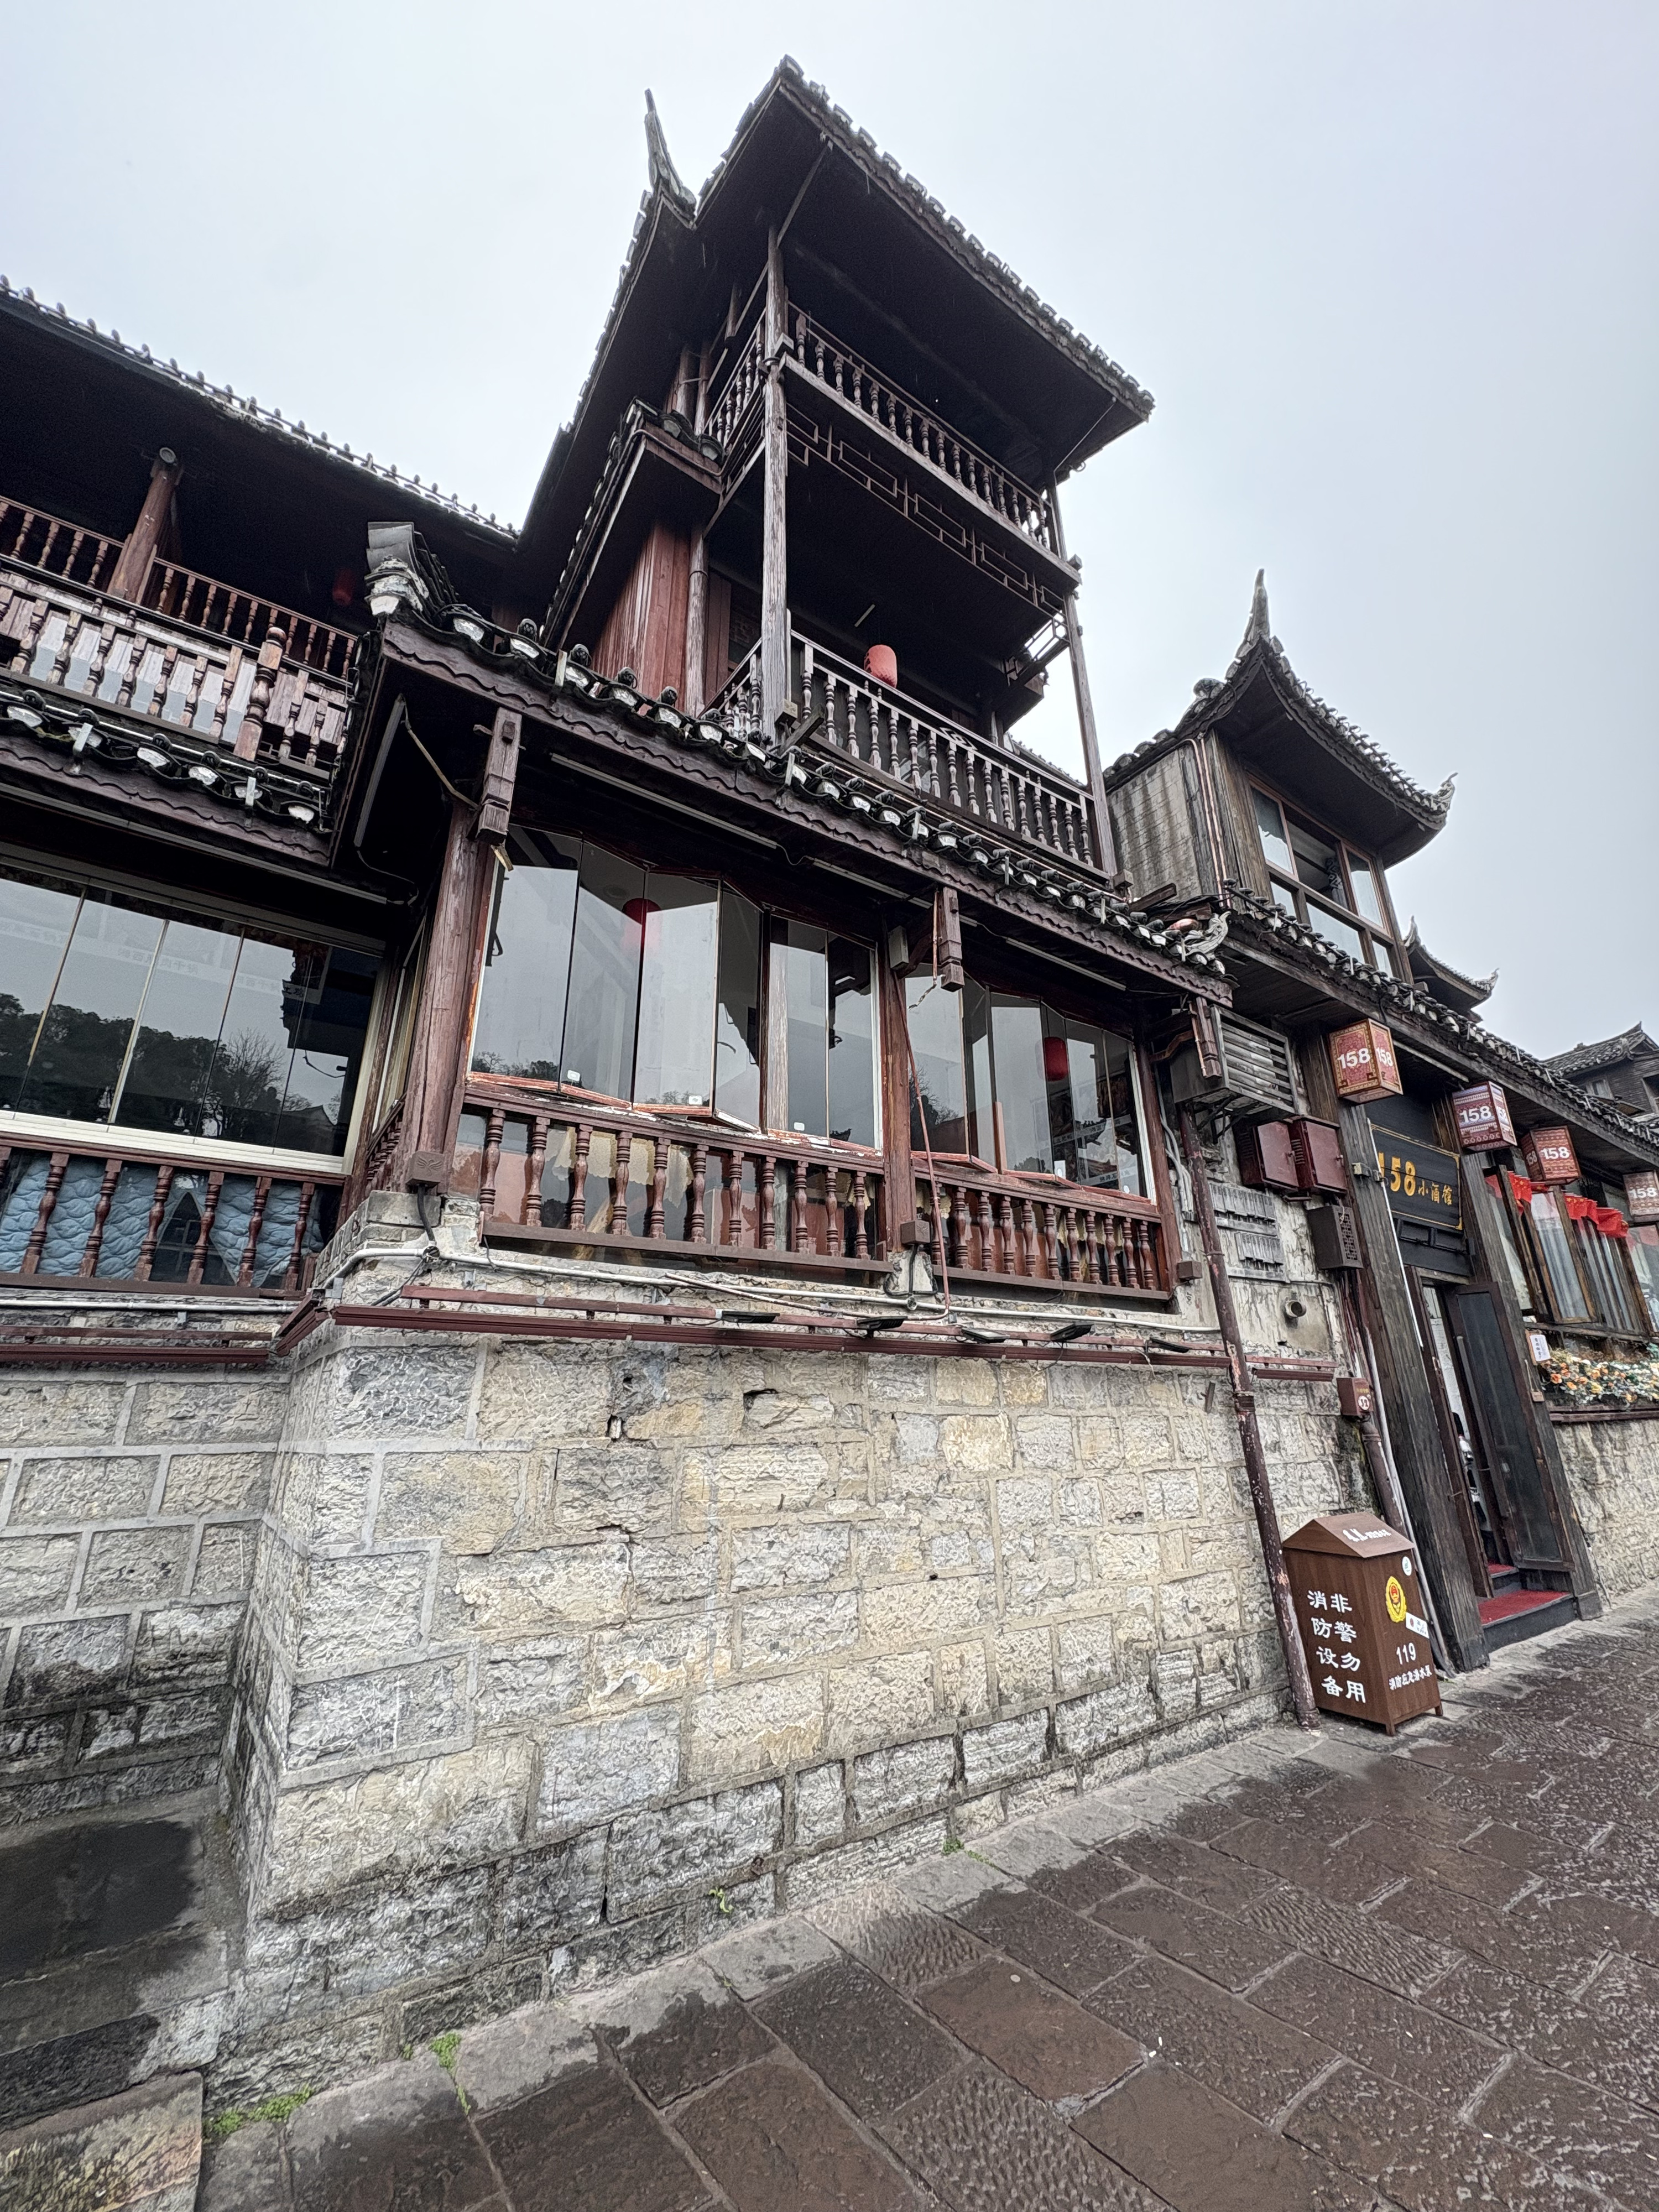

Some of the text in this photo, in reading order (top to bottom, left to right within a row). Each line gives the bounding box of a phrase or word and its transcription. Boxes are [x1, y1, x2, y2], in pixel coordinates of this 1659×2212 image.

[1337, 1048, 1370, 1069] 158
[1376, 1047, 1394, 1067] 158
[1459, 1106, 1492, 1123] 158
[1540, 1146, 1570, 1160] 158
[1629, 1187, 1657, 1199] 158
[1307, 1590, 1343, 1697] 消防设备
[1331, 1593, 1366, 1703] 非警勿用
[1396, 1642, 1416, 1665] 119
